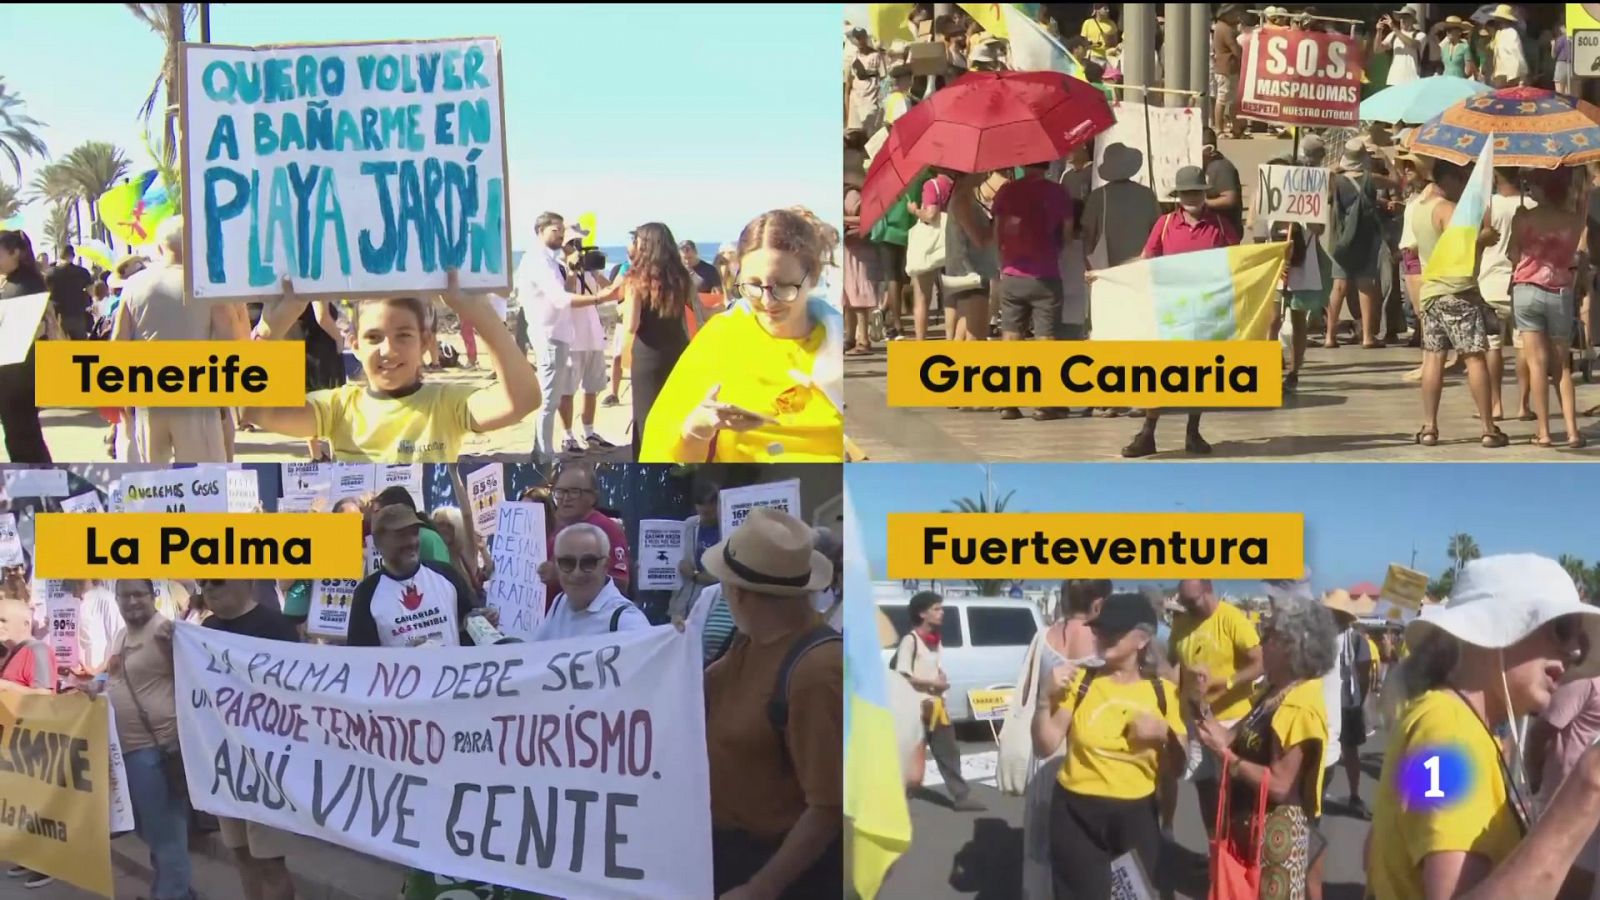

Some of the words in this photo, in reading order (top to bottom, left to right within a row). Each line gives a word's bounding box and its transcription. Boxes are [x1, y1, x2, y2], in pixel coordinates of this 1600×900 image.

[1265, 36, 1353, 80] S.O.S.
[1577, 36, 1599, 46] SOLO
[202, 54, 346, 105] QUIERO
[357, 46, 490, 93] VOLVER
[1256, 79, 1357, 103] MASPALOMAS
[1242, 102, 1279, 115] RESPETA
[1282, 106, 1320, 118] NUESTRO
[1321, 109, 1353, 120] LITORAL
[206, 114, 239, 161] A
[253, 100, 425, 156] BAÑARME
[435, 98, 491, 145] EN
[1283, 168, 1328, 193] AGENDA
[204, 161, 351, 287] PLAYA
[358, 148, 502, 274] JARDÍN
[1286, 193, 1321, 217] 2030
[128, 482, 185, 500] QUEREMOS
[191, 479, 220, 497] CASAS
[53, 619, 76, 630] 90%
[394, 607, 440, 624] CANARIAS
[248, 652, 350, 694] PALMA
[367, 662, 421, 699] NO
[432, 659, 523, 700] DEBE
[542, 645, 621, 691] SER
[216, 686, 309, 743] PARQUE
[311, 708, 446, 766] TEMÁTICO
[453, 728, 493, 753] PARA
[1, 798, 16, 827] La
[18, 803, 68, 843] Palma
[311, 759, 428, 849] VIVE
[445, 782, 645, 880] GENTE
